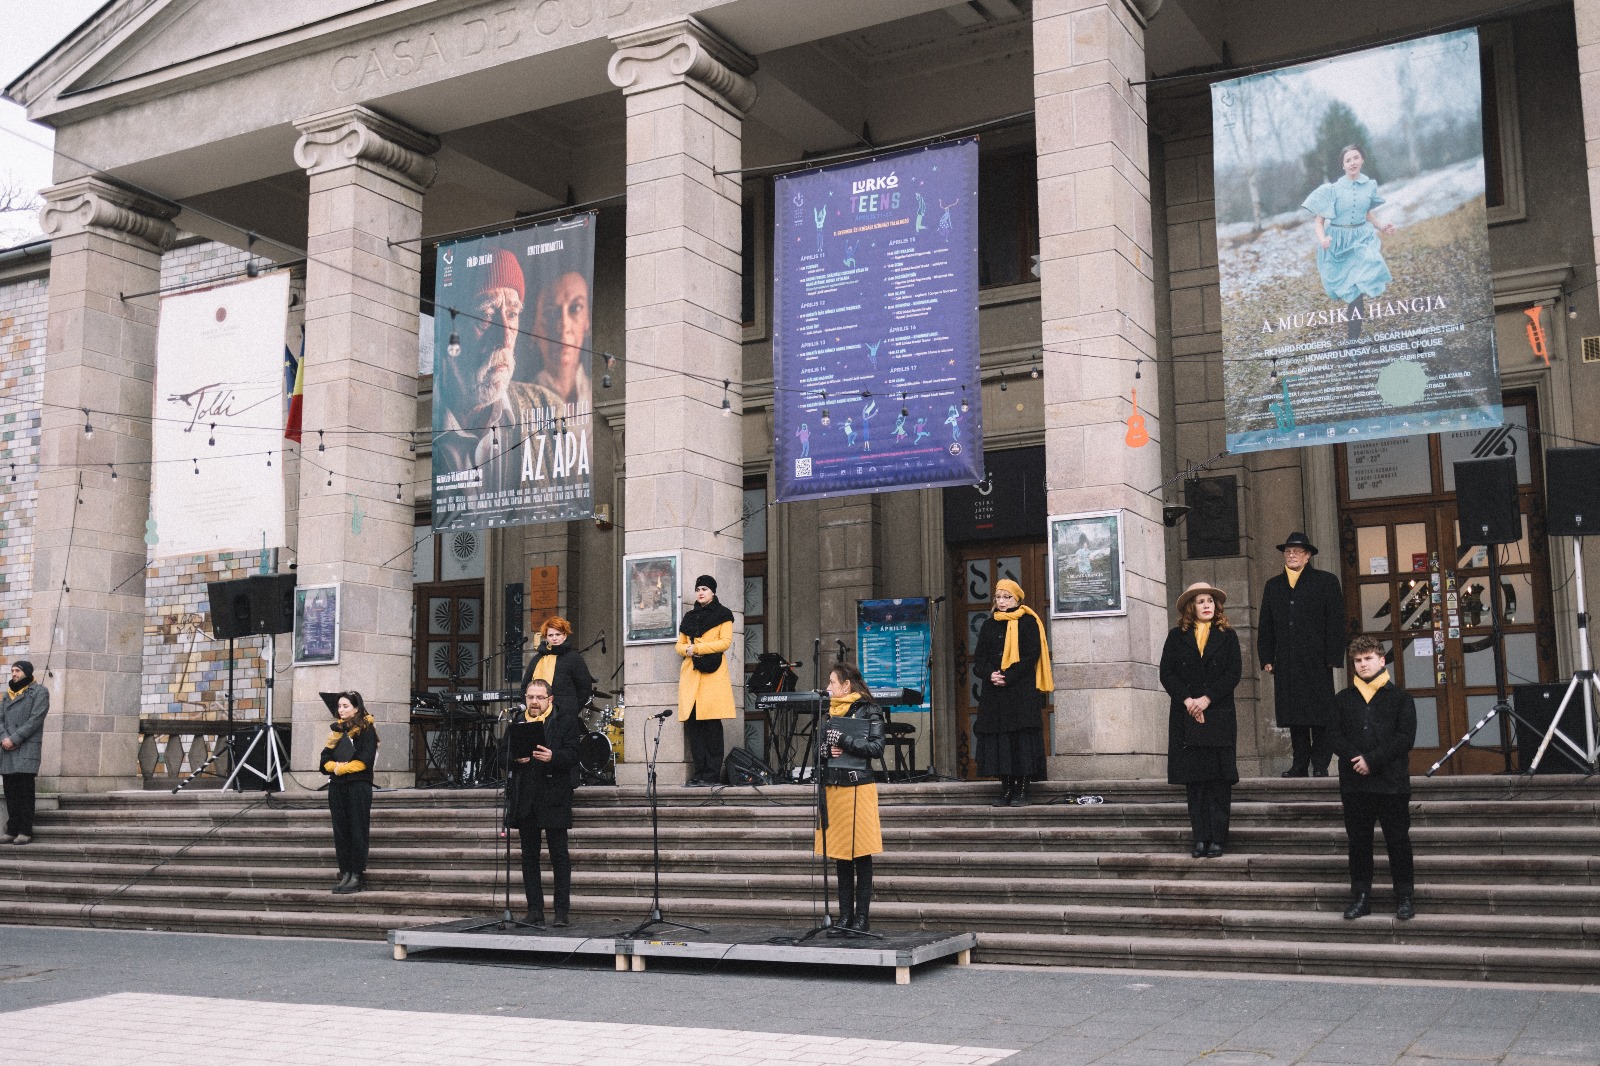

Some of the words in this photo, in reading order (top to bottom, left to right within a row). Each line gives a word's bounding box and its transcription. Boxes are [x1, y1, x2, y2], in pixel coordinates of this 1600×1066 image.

[329, 33, 447, 93] CASA
[462, 7, 521, 60] DE
[852, 171, 899, 195] LURKÓ
[850, 191, 901, 214] TEENS
[888, 237, 908, 246] ÁPRILIS
[800, 253, 818, 262] ÁPRILIS
[800, 300, 818, 309] ÁPRILIS
[1261, 320, 1273, 334] A
[1278, 306, 1363, 332] MUZSIKA
[1368, 295, 1447, 319] HANGJA
[889, 325, 909, 334] ÁPRILIS
[800, 340, 819, 349] ÁPRILIS
[1264, 345, 1295, 358] RICHARD
[1295, 340, 1332, 353] RODGERS
[1373, 329, 1401, 342] OSCAR
[1304, 349, 1338, 363] HOWARD
[1338, 346, 1371, 358] LINDSAY
[1379, 341, 1410, 353] RUSSEL
[800, 366, 819, 374] ÁPRILIS
[890, 365, 910, 374] ÁPRILIS
[522, 406, 556, 432] FLORIAN
[1451, 430, 1482, 438] KULISSZA
[521, 434, 546, 481] AZ
[552, 429, 590, 479] APA
[463, 693, 474, 701] M1
[482, 692, 500, 700] KORG
